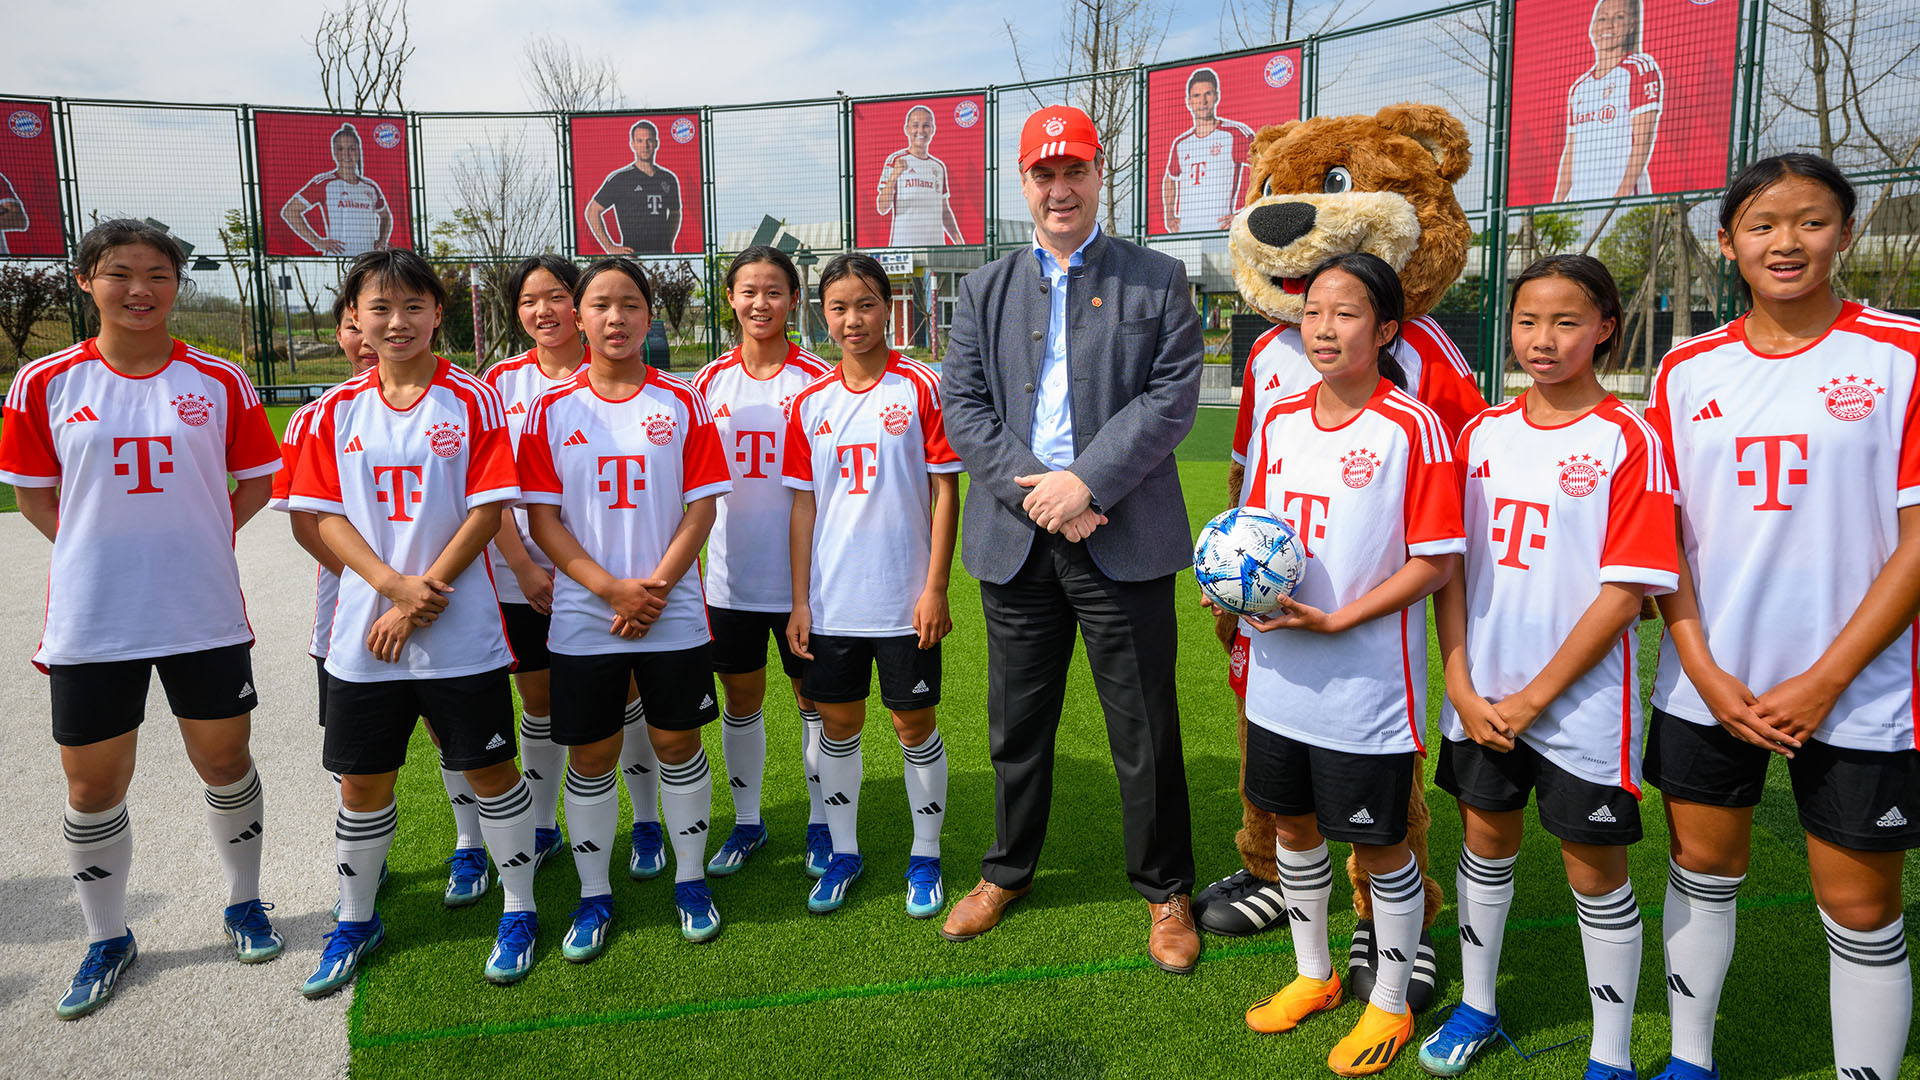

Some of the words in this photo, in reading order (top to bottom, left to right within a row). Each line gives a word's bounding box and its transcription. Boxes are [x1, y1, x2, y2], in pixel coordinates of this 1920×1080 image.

[905, 178, 933, 189] Allianz
[337, 199, 370, 210] Allianz
[647, 194, 663, 215] T
[1830, 390, 1840, 400] FC
[1840, 386, 1872, 401] BAYERN
[113, 436, 174, 494] T
[735, 431, 776, 479] T
[837, 443, 877, 495] T
[1574, 465, 1596, 480] BAYERN
[1735, 433, 1809, 511] T
[598, 456, 646, 509] T
[373, 466, 424, 522] T
[1284, 492, 1329, 558] T
[1492, 498, 1549, 570] T
[485, 739, 506, 750] adidas
[1349, 816, 1375, 824] adidas
[1588, 814, 1617, 823] adidas
[1876, 817, 1908, 827] adidas
